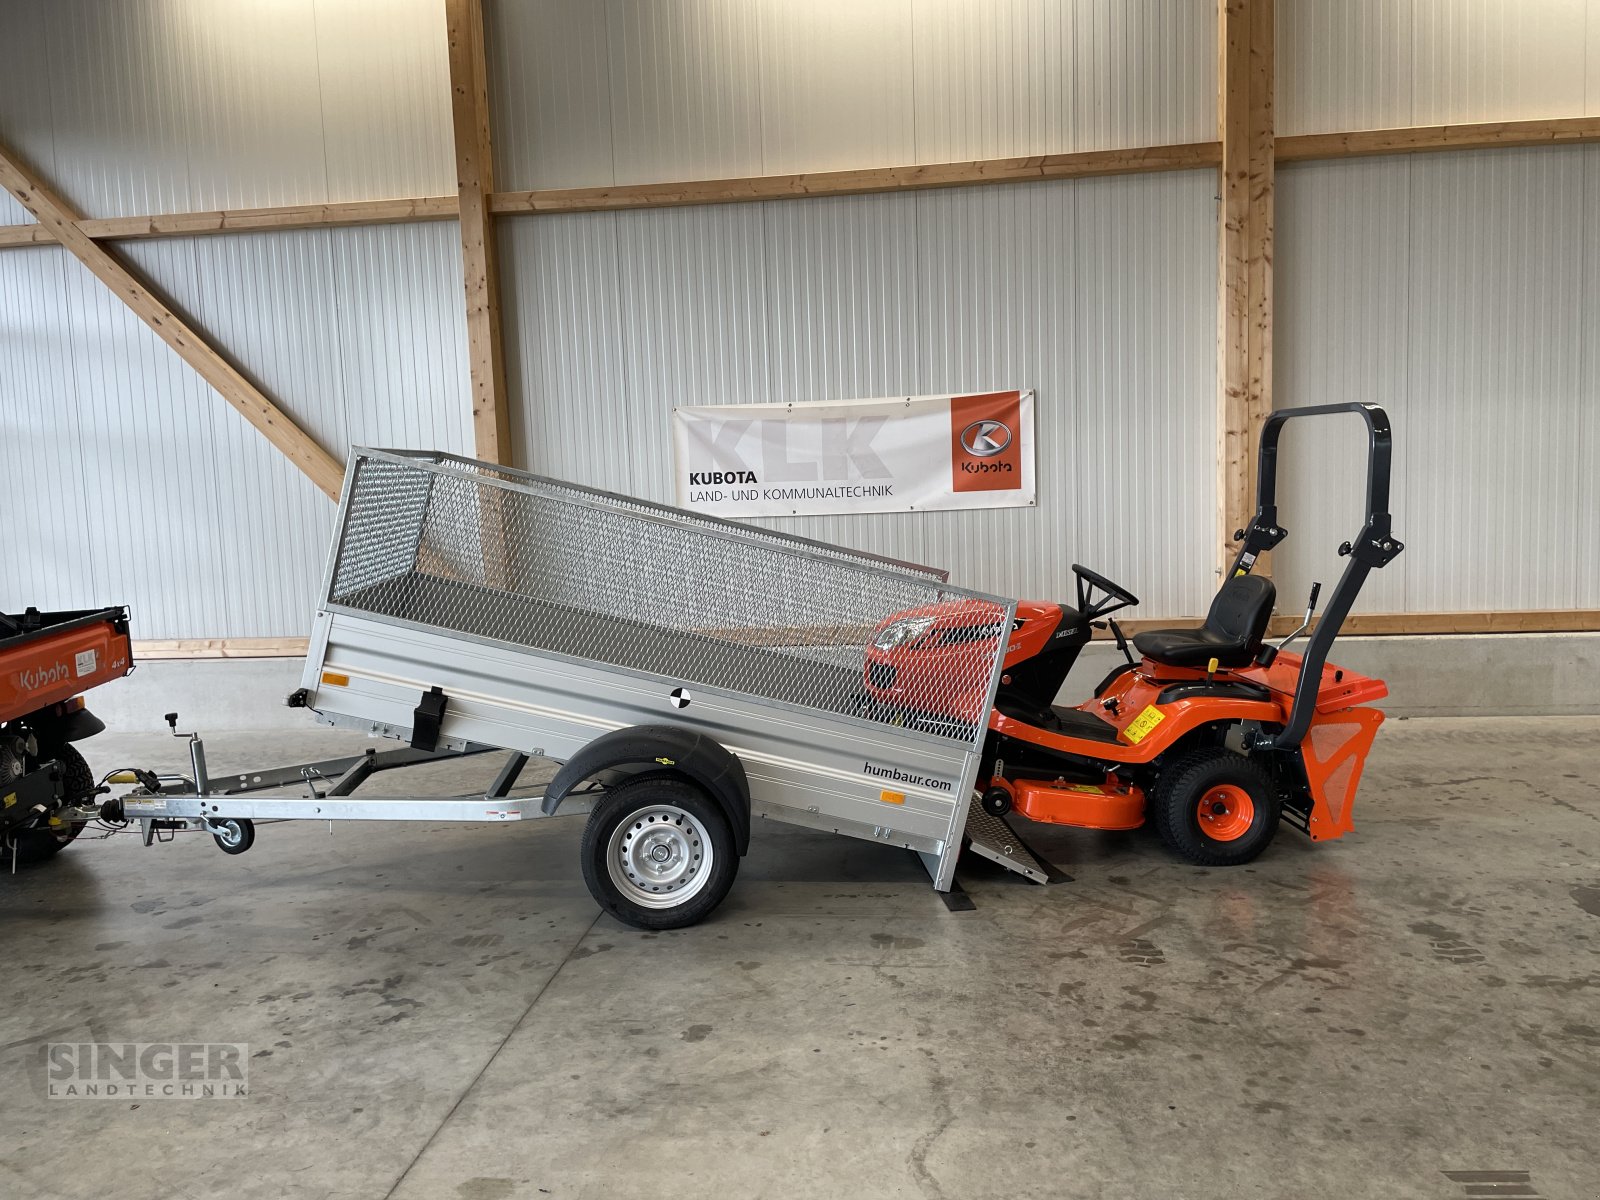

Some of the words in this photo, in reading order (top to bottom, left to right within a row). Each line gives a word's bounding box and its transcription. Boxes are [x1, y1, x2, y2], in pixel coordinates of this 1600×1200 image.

[687, 415, 895, 482] KLK
[961, 460, 1012, 473] Kubota
[689, 471, 758, 486] KUBOTA
[690, 490, 728, 502] LAND-
[732, 489, 759, 501] UND
[764, 485, 893, 500] KOMMUNALTECHNIK
[112, 657, 125, 669] 4x4
[20, 661, 70, 691] Kubota
[863, 762, 952, 791] humbaur.com
